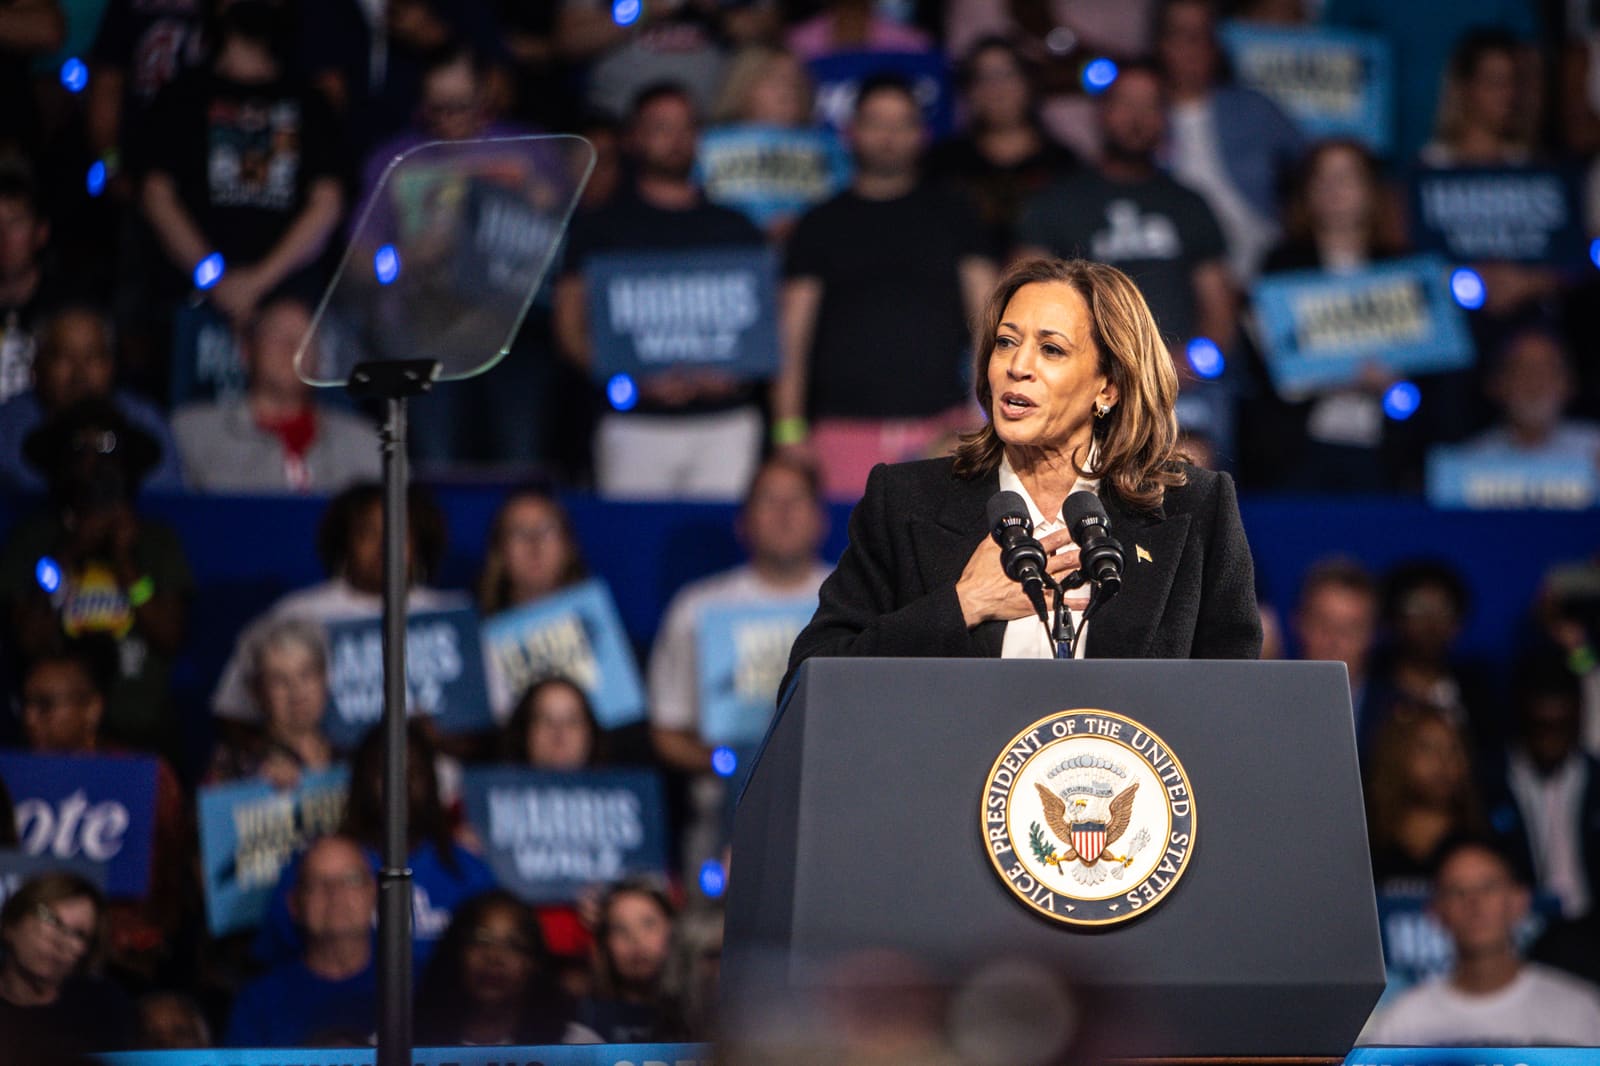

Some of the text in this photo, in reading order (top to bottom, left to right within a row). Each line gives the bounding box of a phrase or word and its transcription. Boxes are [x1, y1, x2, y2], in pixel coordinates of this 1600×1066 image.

[15, 786, 130, 861] ote
[488, 786, 643, 848] HARRIS
[986, 717, 1191, 911] VICE PRESIDENT OF THE UNITED STATES
